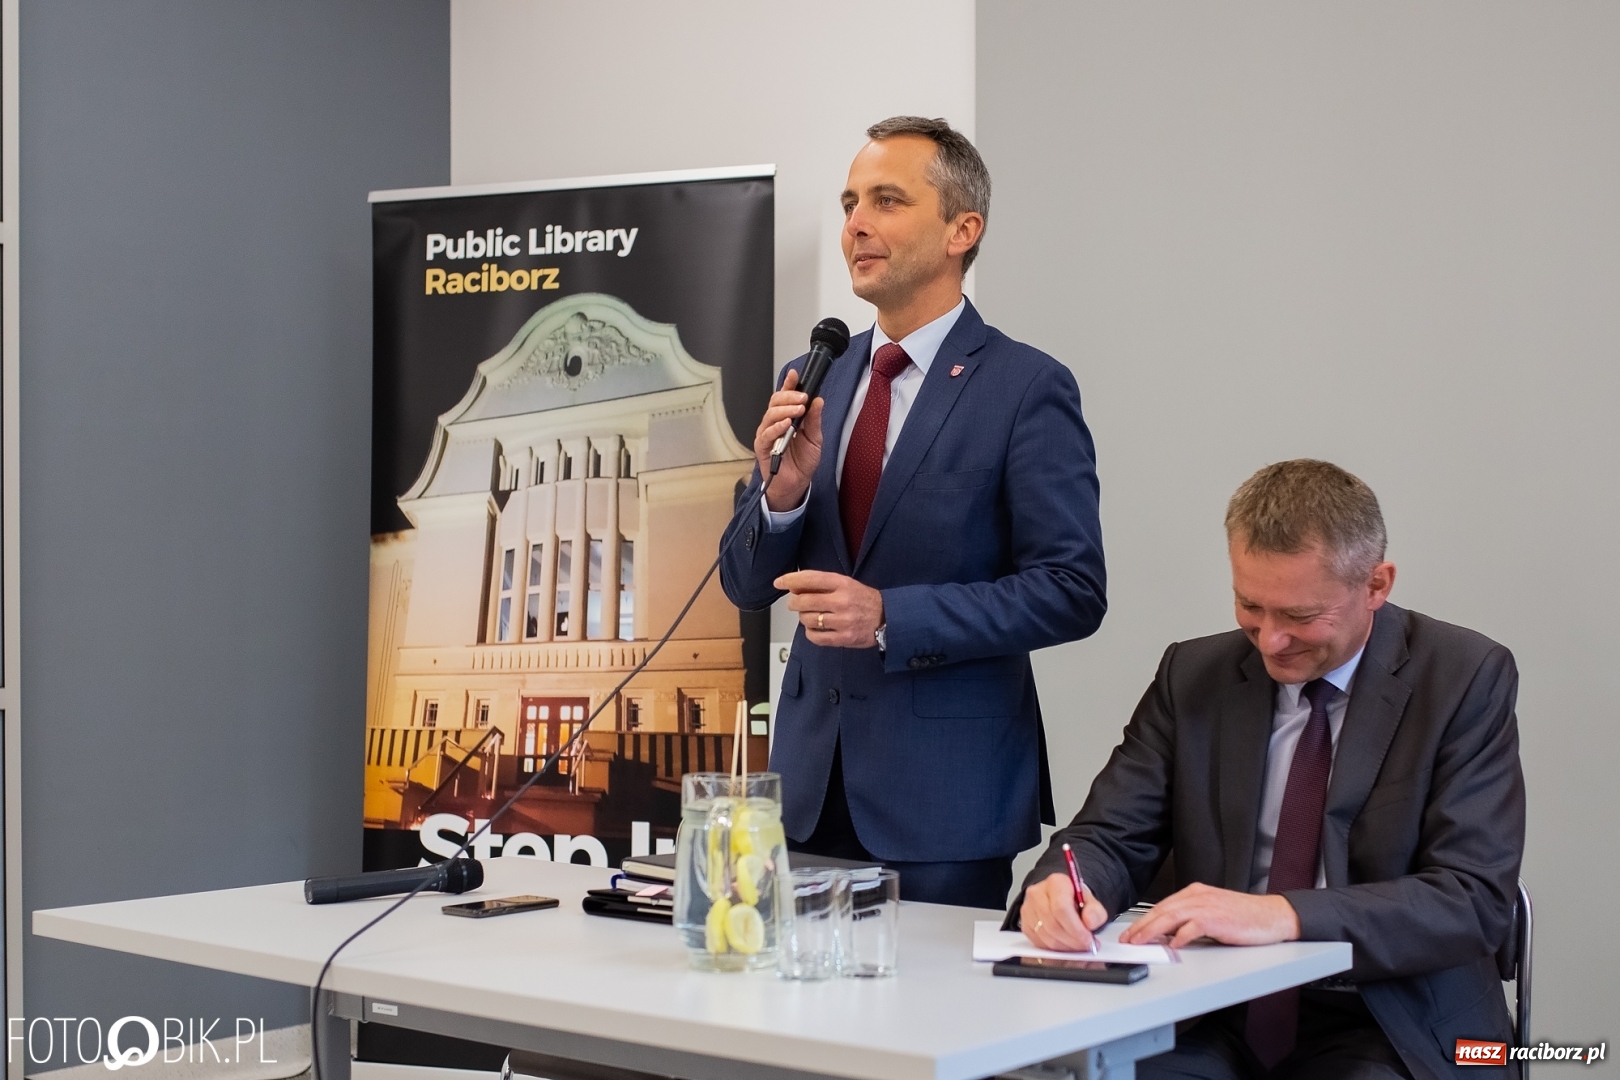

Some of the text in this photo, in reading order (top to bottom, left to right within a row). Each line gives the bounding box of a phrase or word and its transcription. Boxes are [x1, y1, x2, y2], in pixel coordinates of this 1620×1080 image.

[426, 224, 639, 261] Public Library
[425, 262, 560, 295] Raciborz
